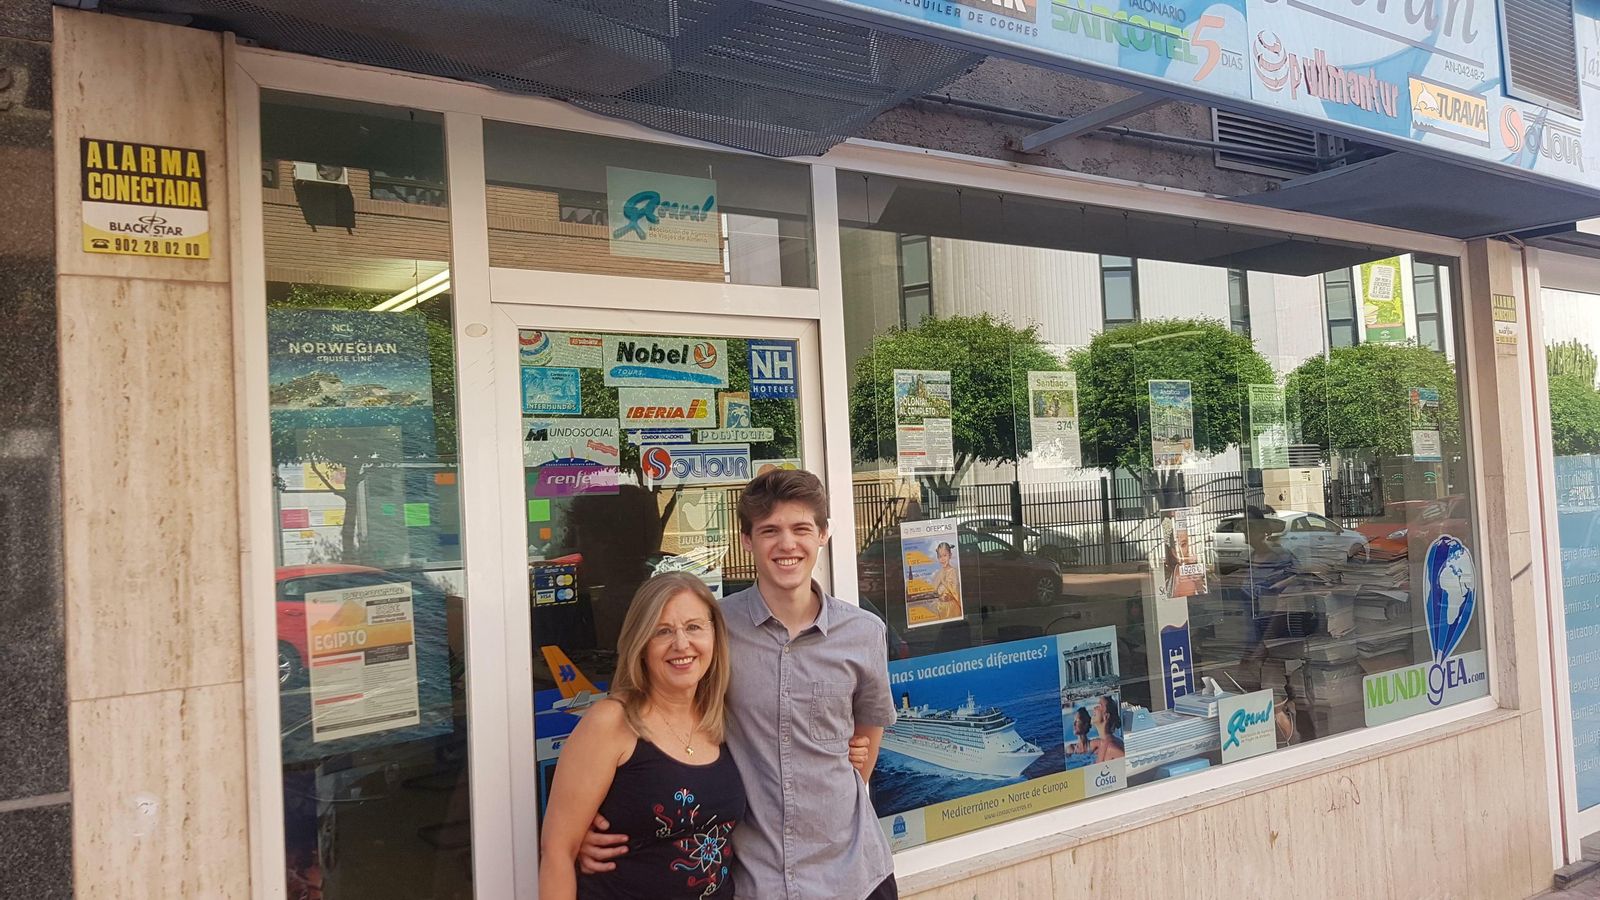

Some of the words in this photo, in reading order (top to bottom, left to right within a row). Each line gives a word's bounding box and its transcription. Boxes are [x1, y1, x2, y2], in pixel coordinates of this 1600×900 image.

[899, 0, 961, 18] LQUILER
[968, 11, 984, 24] DE
[990, 17, 1039, 37] COCHES
[1191, 15, 1226, 81] 5
[1221, 52, 1243, 71] DIAS
[1437, 92, 1487, 130] TURAVIA
[86, 141, 202, 179] ALARMA
[87, 172, 203, 208] CONECTADA
[109, 221, 150, 235] BLACK
[153, 224, 183, 236] STAR
[115, 238, 138, 252] 902
[144, 240, 159, 253] 28
[165, 242, 180, 255] 02
[185, 243, 200, 256] 00
[289, 342, 397, 354] NORWEGIAN
[616, 341, 690, 364] Nobel
[317, 355, 350, 363] CRUISE
[751, 351, 794, 379] NH
[753, 385, 795, 394] HOTELES
[1036, 378, 1069, 390] Santiago
[626, 406, 685, 419] IBERIA
[547, 470, 592, 489] renfe
[925, 523, 953, 533] OFERTAS
[314, 629, 368, 652] EGIPTO
[916, 658, 984, 680] vacaciones
[986, 645, 1049, 669] diferentes?
[1095, 774, 1117, 788] Costa
[941, 797, 1000, 821] Mediterráneo
[1008, 790, 1030, 804] Norte
[1031, 786, 1041, 798] de
[1043, 780, 1069, 796] Europa
